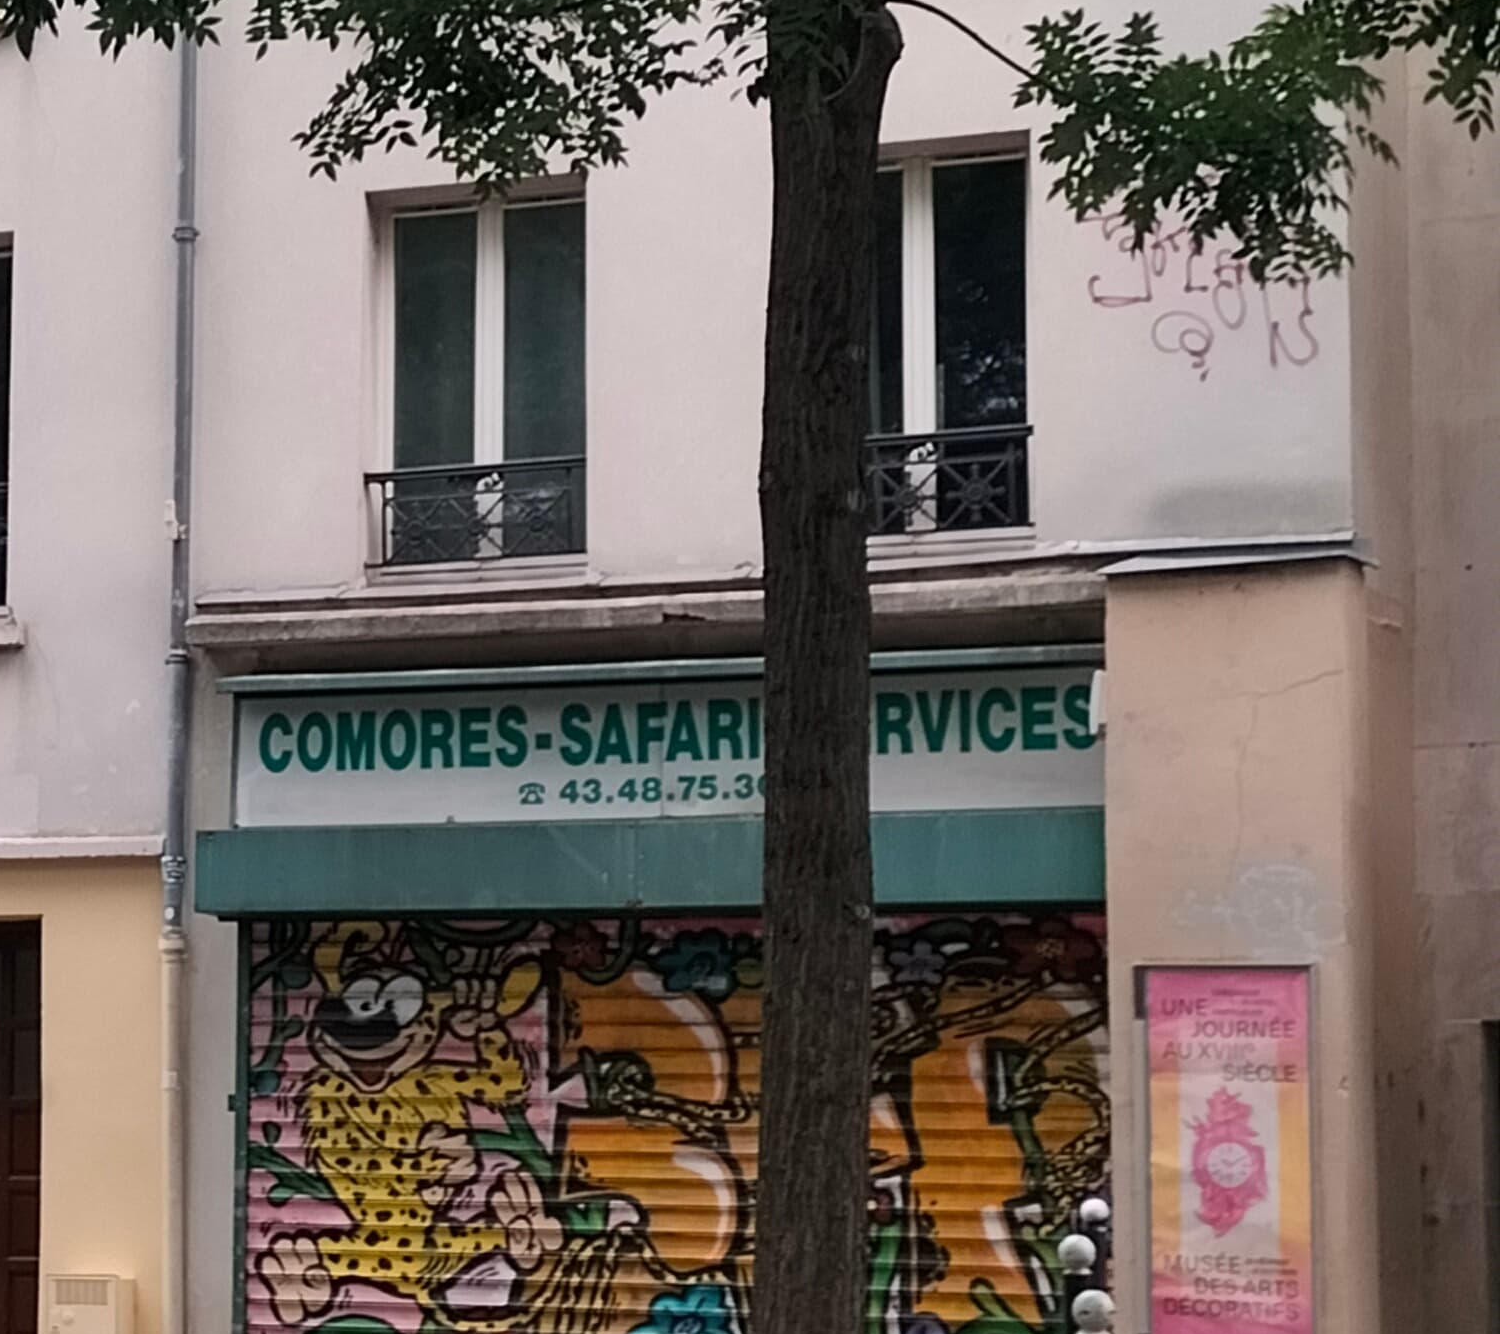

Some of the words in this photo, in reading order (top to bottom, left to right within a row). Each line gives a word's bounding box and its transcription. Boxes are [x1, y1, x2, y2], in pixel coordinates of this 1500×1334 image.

[876, 684, 1098, 755] RVICES
[559, 774, 764, 804] 43.48.75.3
[1161, 998, 1208, 1016] UNE
[1192, 1017, 1297, 1038] JOURNÉE
[1162, 1041, 1191, 1059] AU
[1164, 1252, 1241, 1274] MUSÉE
[1194, 1277, 1237, 1295] DES
[1243, 1279, 1299, 1299] ARTS
[1163, 1295, 1299, 1320] DÉCORATIFS
